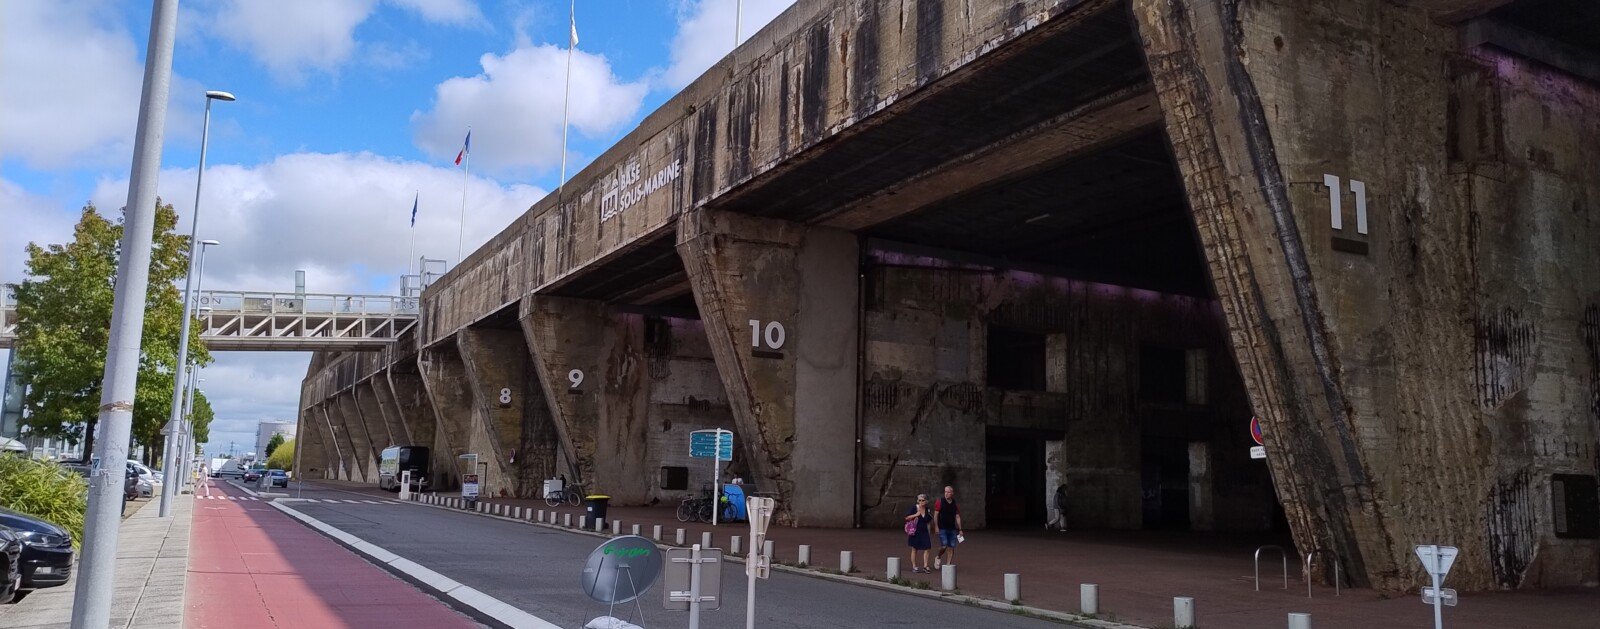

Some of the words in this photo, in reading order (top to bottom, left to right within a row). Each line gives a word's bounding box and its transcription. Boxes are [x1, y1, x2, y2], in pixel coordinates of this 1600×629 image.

[620, 159, 680, 212] SOUS-MARINE
[621, 162, 641, 191] BASE
[1324, 174, 1368, 235] 11
[749, 319, 786, 350] 10
[568, 368, 584, 388] 9
[500, 387, 512, 404] 8
